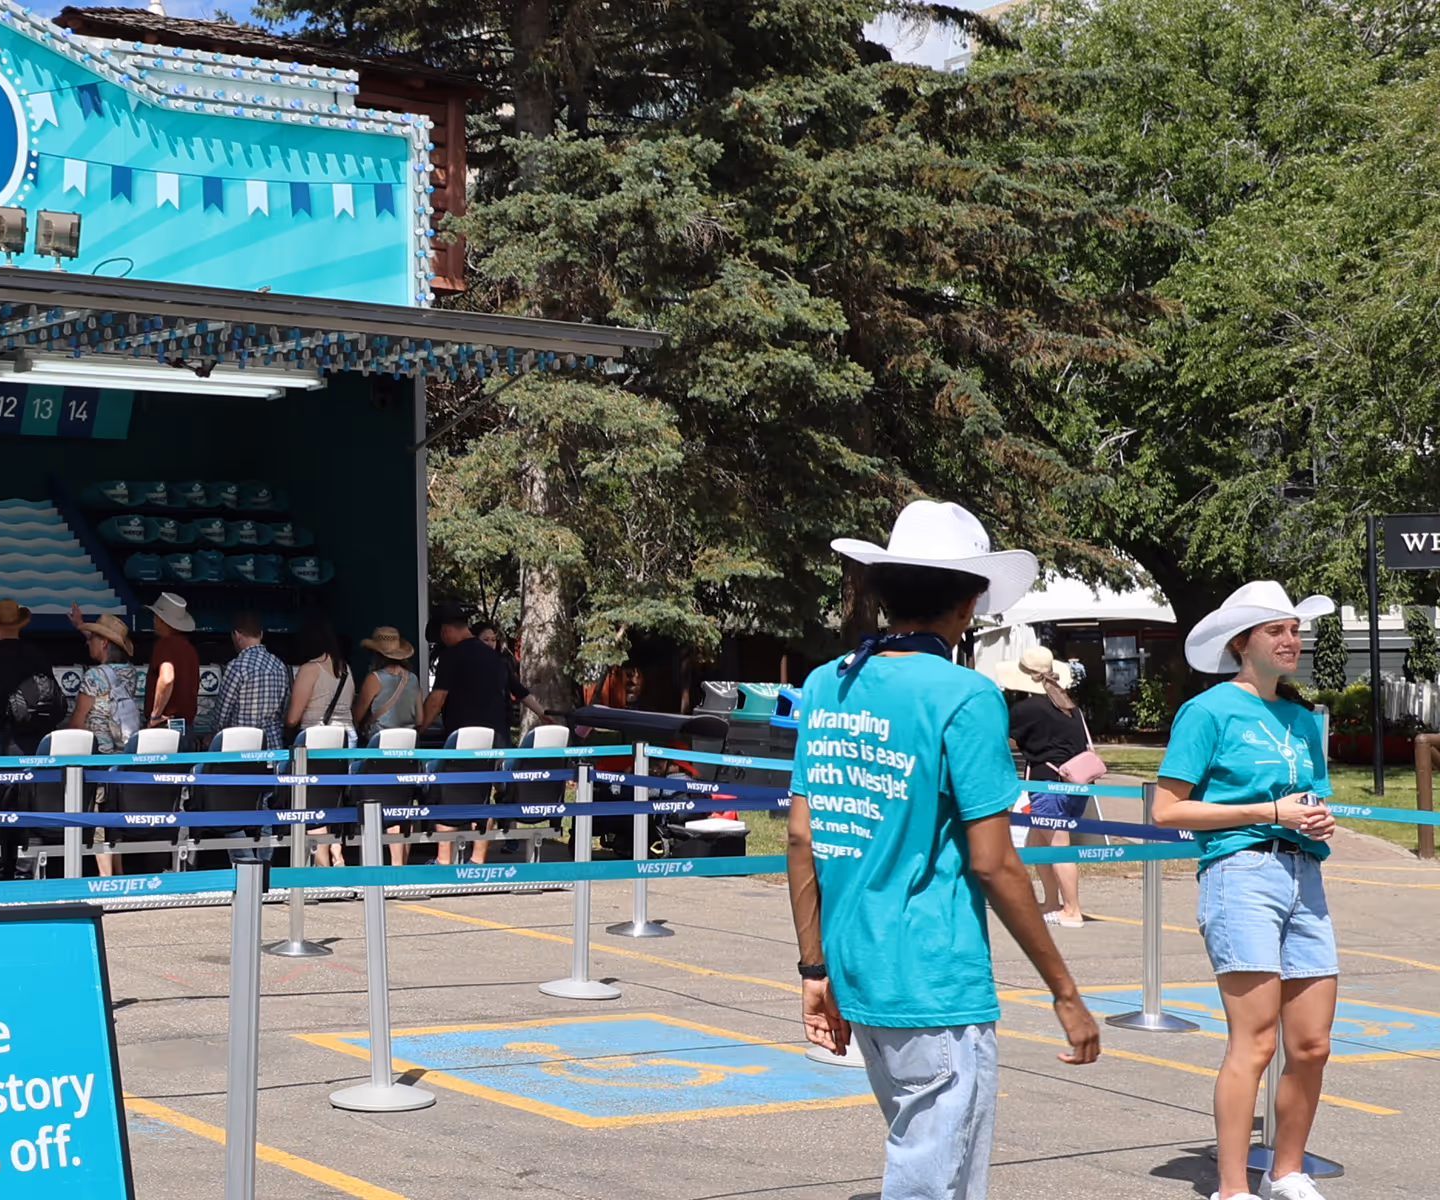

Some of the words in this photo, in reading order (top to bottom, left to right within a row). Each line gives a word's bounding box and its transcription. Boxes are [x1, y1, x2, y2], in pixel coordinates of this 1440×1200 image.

[33, 398, 53, 420] 13
[68, 400, 88, 422] 14
[860, 739, 875, 764] is
[876, 748, 916, 777] easy
[153, 774, 187, 784] WESTJET
[277, 776, 310, 785] WESTJET
[396, 774, 428, 784] WESTJET
[512, 771, 543, 782] WESTJET
[595, 772, 618, 783] WESTJET
[686, 782, 712, 793] WESTJET
[846, 765, 909, 801] WestJet
[1048, 783, 1080, 793] WESTJET
[382, 807, 420, 819] WESTJET
[521, 805, 557, 817] WESTJET
[652, 801, 687, 814] WESTJET
[124, 814, 166, 826] WESTJET
[276, 811, 316, 823] WESTJET
[1031, 816, 1068, 829] WESTJET
[810, 817, 824, 831] sk
[826, 821, 849, 834] me
[1078, 847, 1115, 860] WESTJET
[456, 866, 505, 882] WESTJET
[636, 861, 684, 877] WESTJET
[87, 877, 148, 895] WESTJET
[9, 1123, 81, 1174] off.
